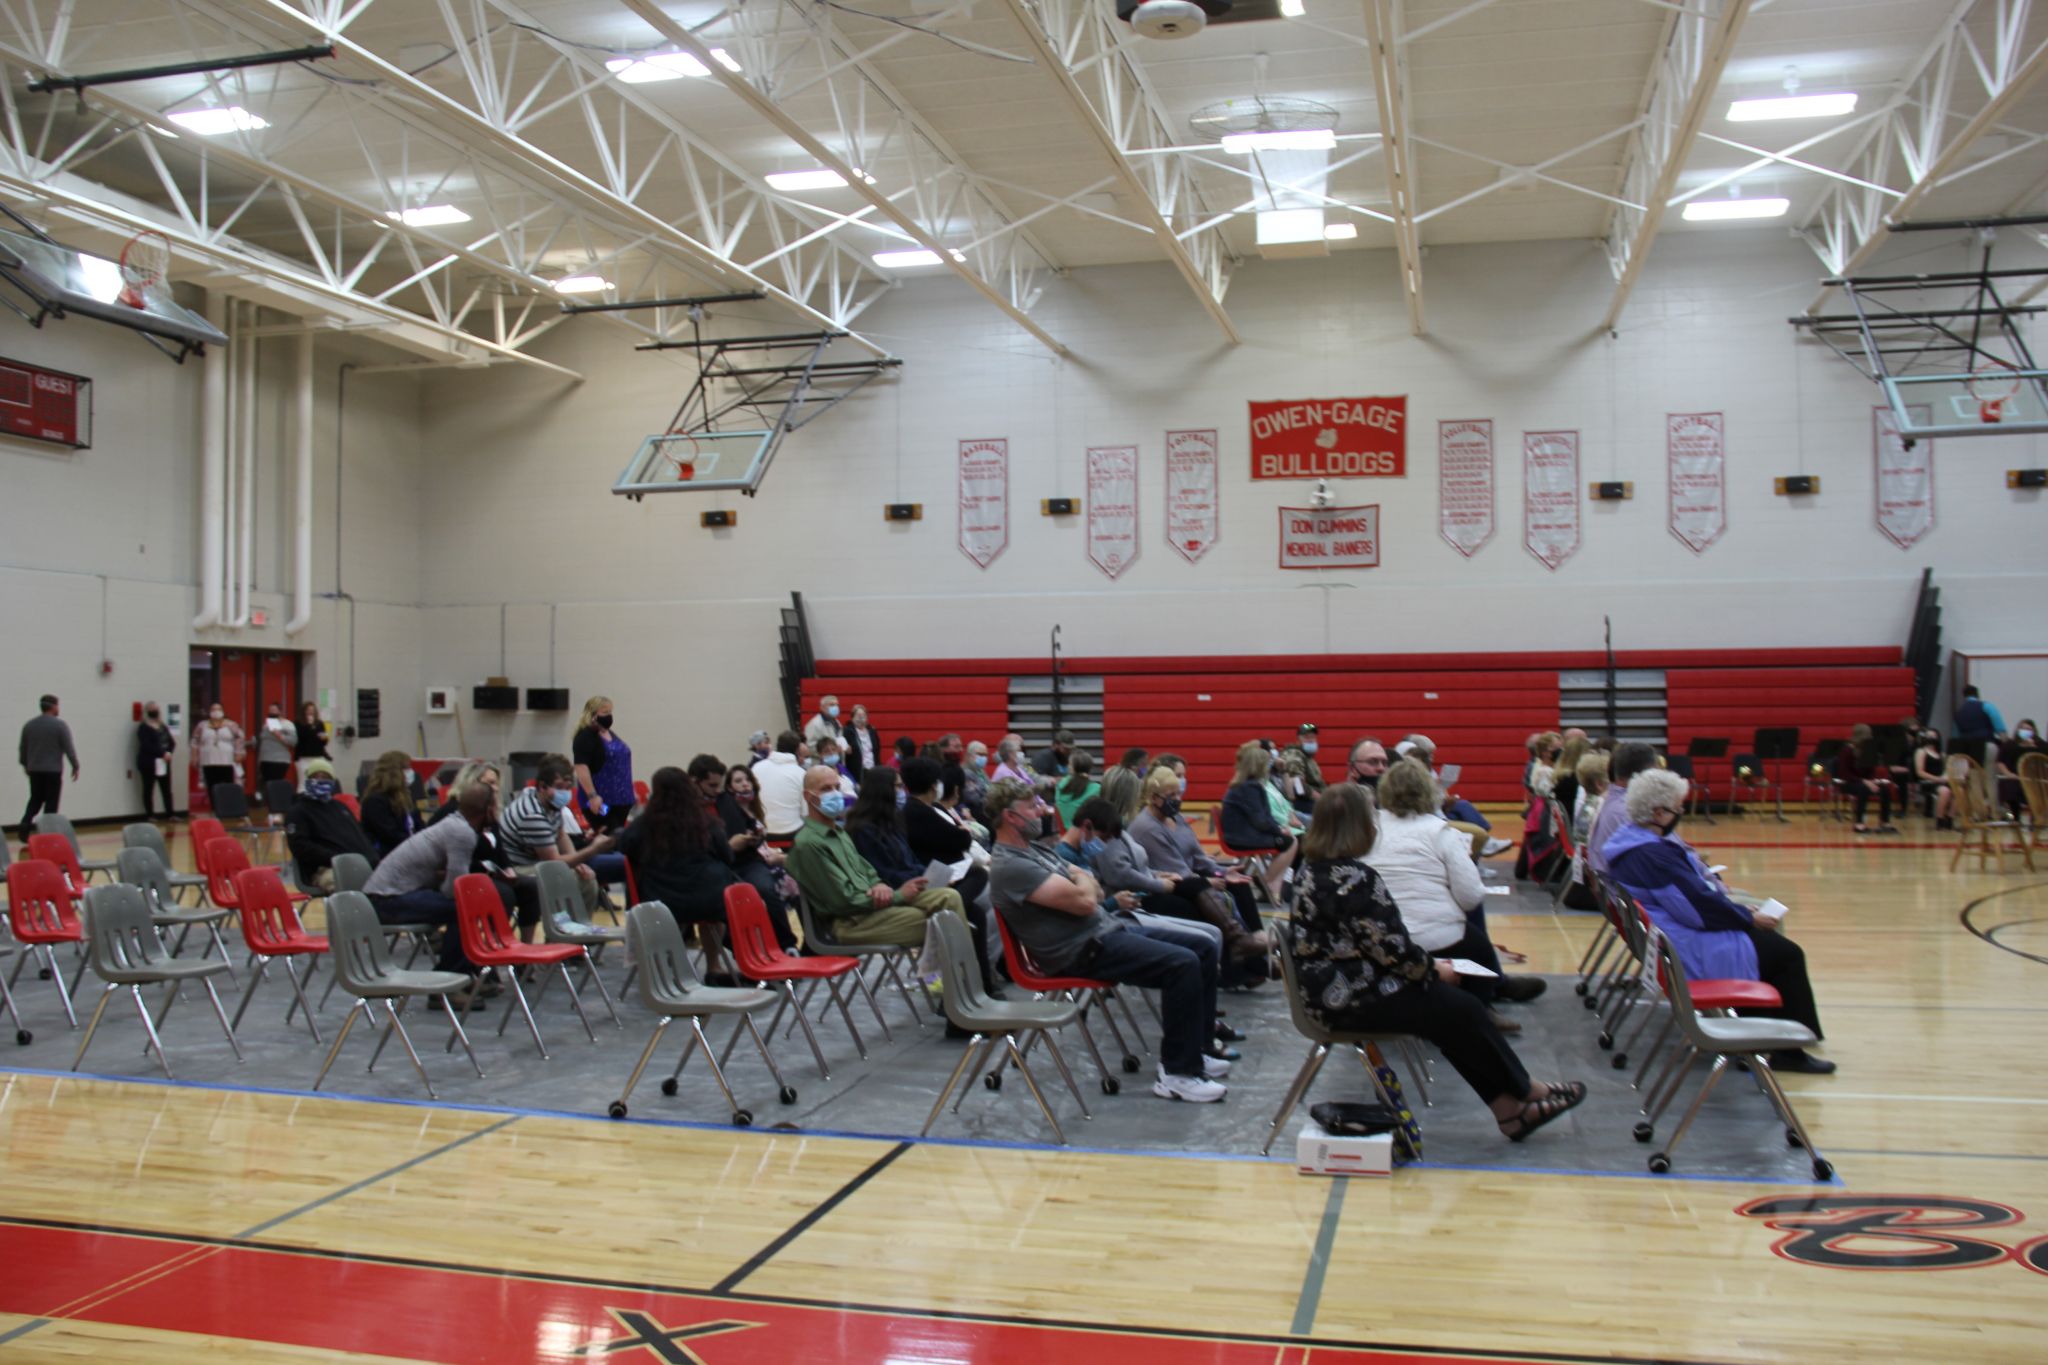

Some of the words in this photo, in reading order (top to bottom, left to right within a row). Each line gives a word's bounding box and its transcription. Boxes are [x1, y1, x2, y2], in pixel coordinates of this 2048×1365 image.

[35, 374, 72, 396] GUEST
[1252, 401, 1404, 439] OWEN-GAGE
[1260, 451, 1396, 476] BULLDOGS
[1291, 519, 1314, 534] DON
